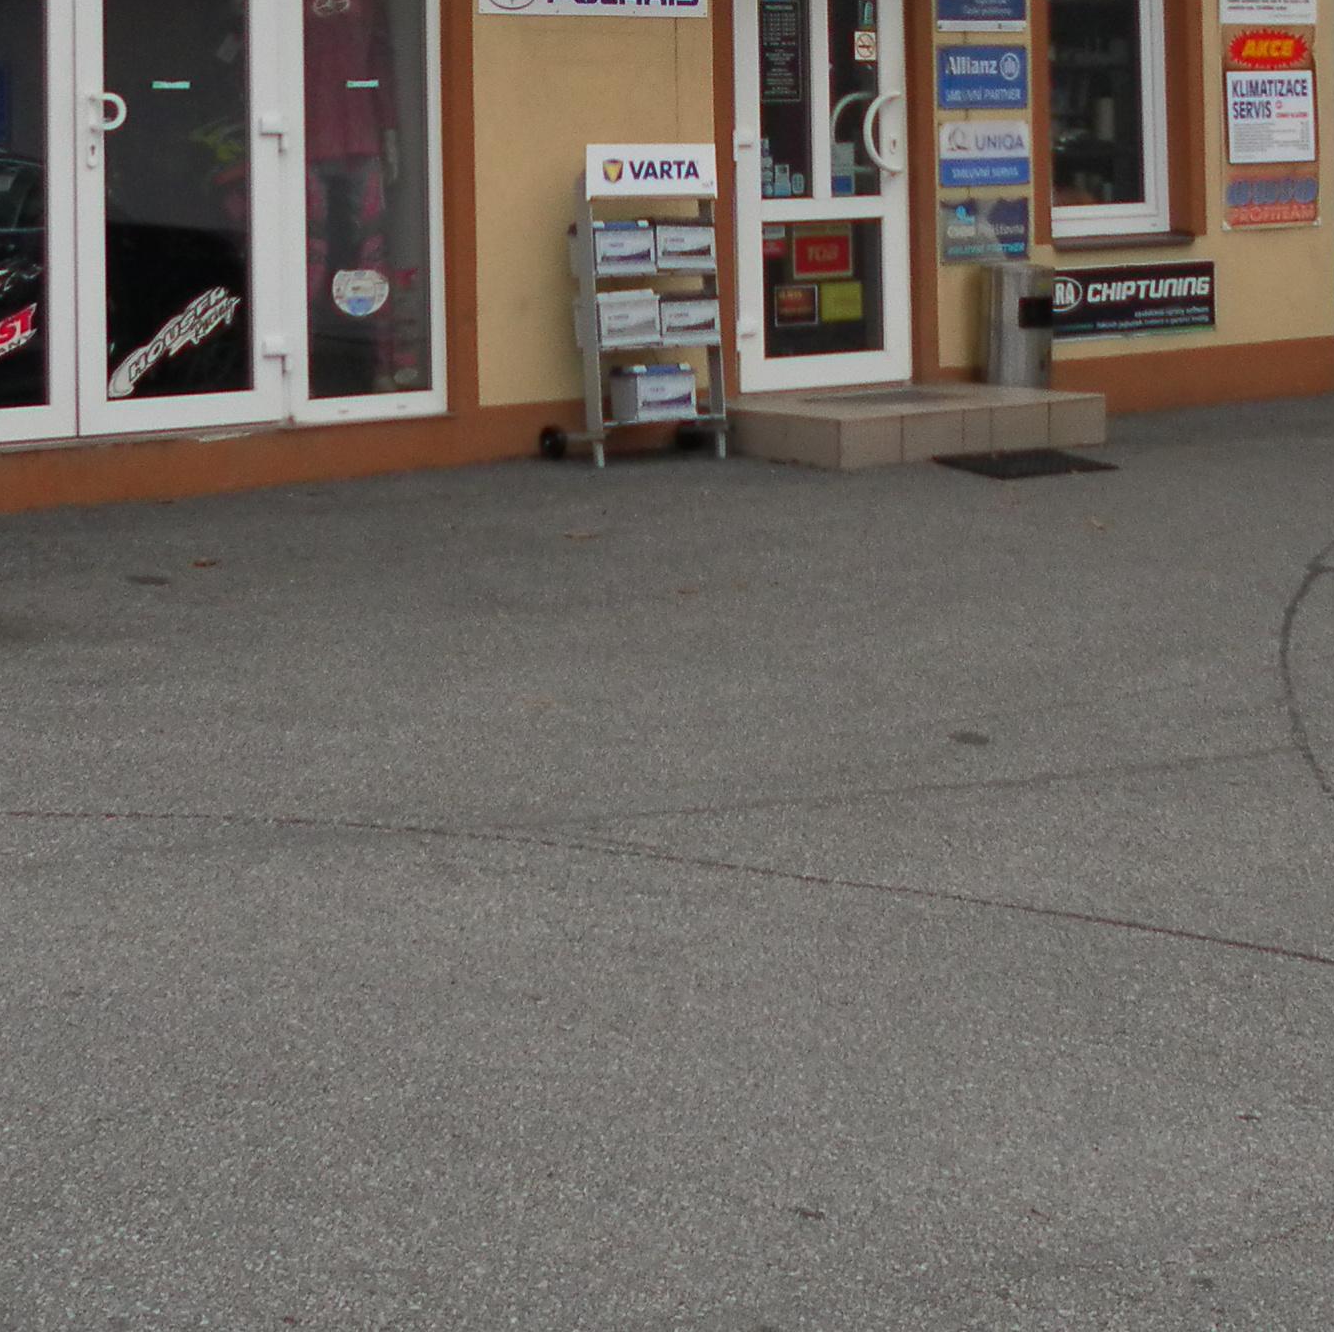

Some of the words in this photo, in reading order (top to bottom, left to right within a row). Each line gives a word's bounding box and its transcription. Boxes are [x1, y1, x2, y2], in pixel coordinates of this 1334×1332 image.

[1241, 39, 1294, 57] AKCE
[945, 56, 998, 76] Allianz
[1232, 79, 1308, 98] KLIMATIZACE
[1233, 101, 1272, 119] SERVIS
[975, 133, 1025, 152] UNIQA
[629, 159, 700, 181] VARTA
[1086, 276, 1211, 303] CHIPTUNING
